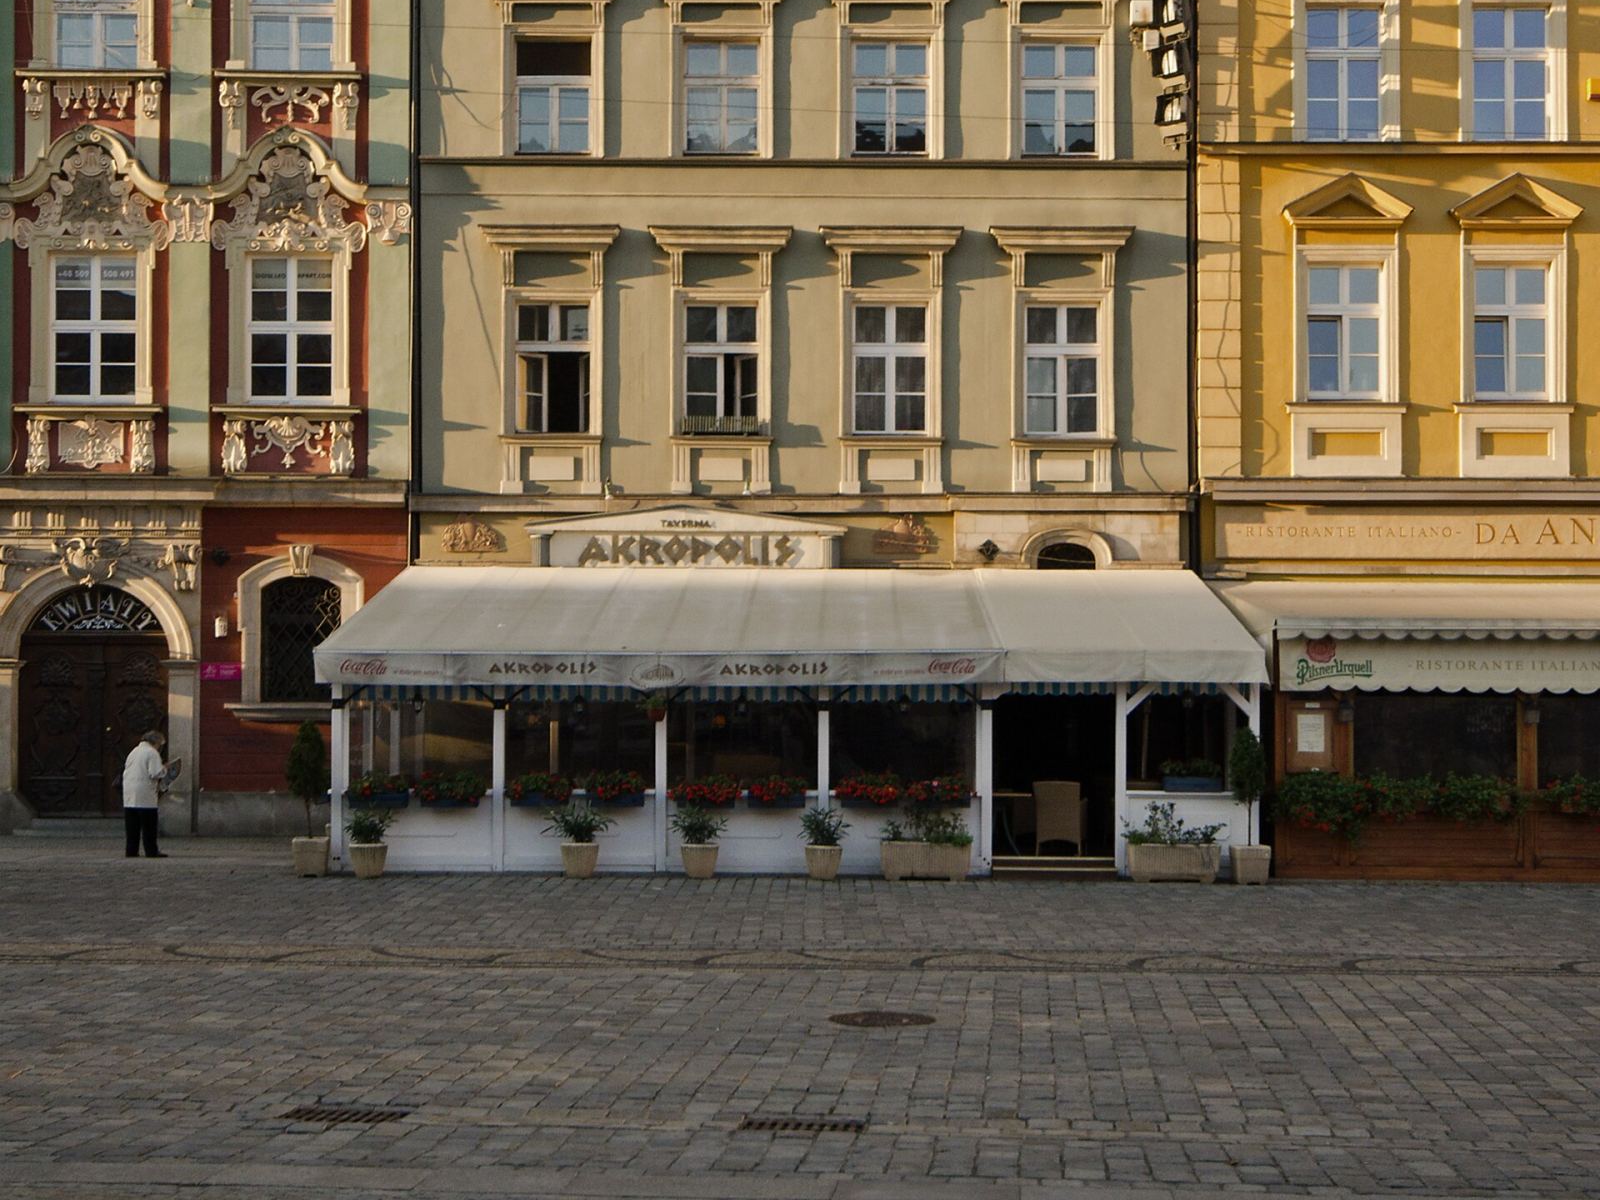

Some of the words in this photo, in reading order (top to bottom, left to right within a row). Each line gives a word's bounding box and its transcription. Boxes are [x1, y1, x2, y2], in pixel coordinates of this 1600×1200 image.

[660, 519, 712, 529] TAVERNA
[1475, 522, 1520, 545] DA
[578, 534, 796, 568] AKROPOLIS
[41, 591, 157, 631] KWIATY
[488, 661, 596, 674] AKROPOLIS
[720, 661, 828, 675] AKROPOLIS
[1296, 658, 1337, 685] Pilsner
[1333, 658, 1373, 678] Urquell
